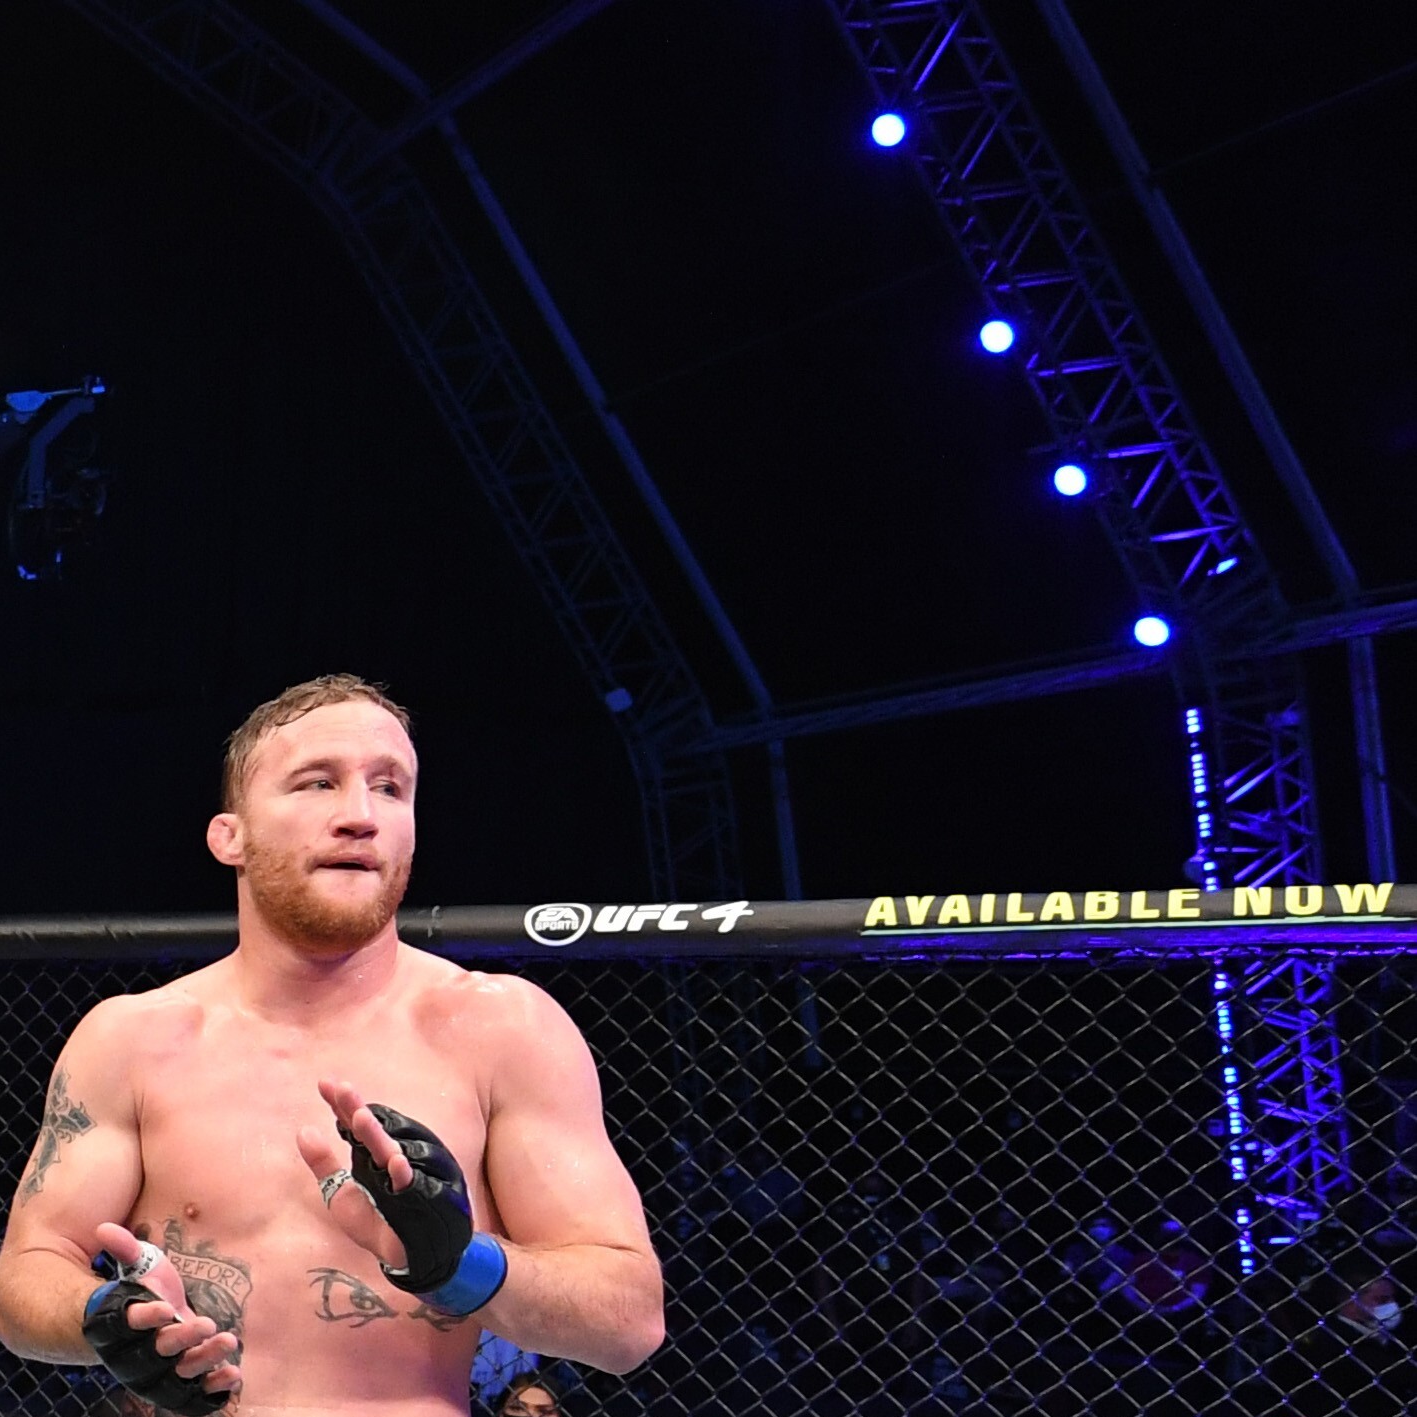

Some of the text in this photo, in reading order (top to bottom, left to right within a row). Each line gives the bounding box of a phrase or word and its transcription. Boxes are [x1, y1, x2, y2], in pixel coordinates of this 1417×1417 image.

[592, 903, 700, 933] UFC
[864, 882, 1394, 927] AVAILABLE NOW
[169, 1255, 246, 1297] BEFORE
